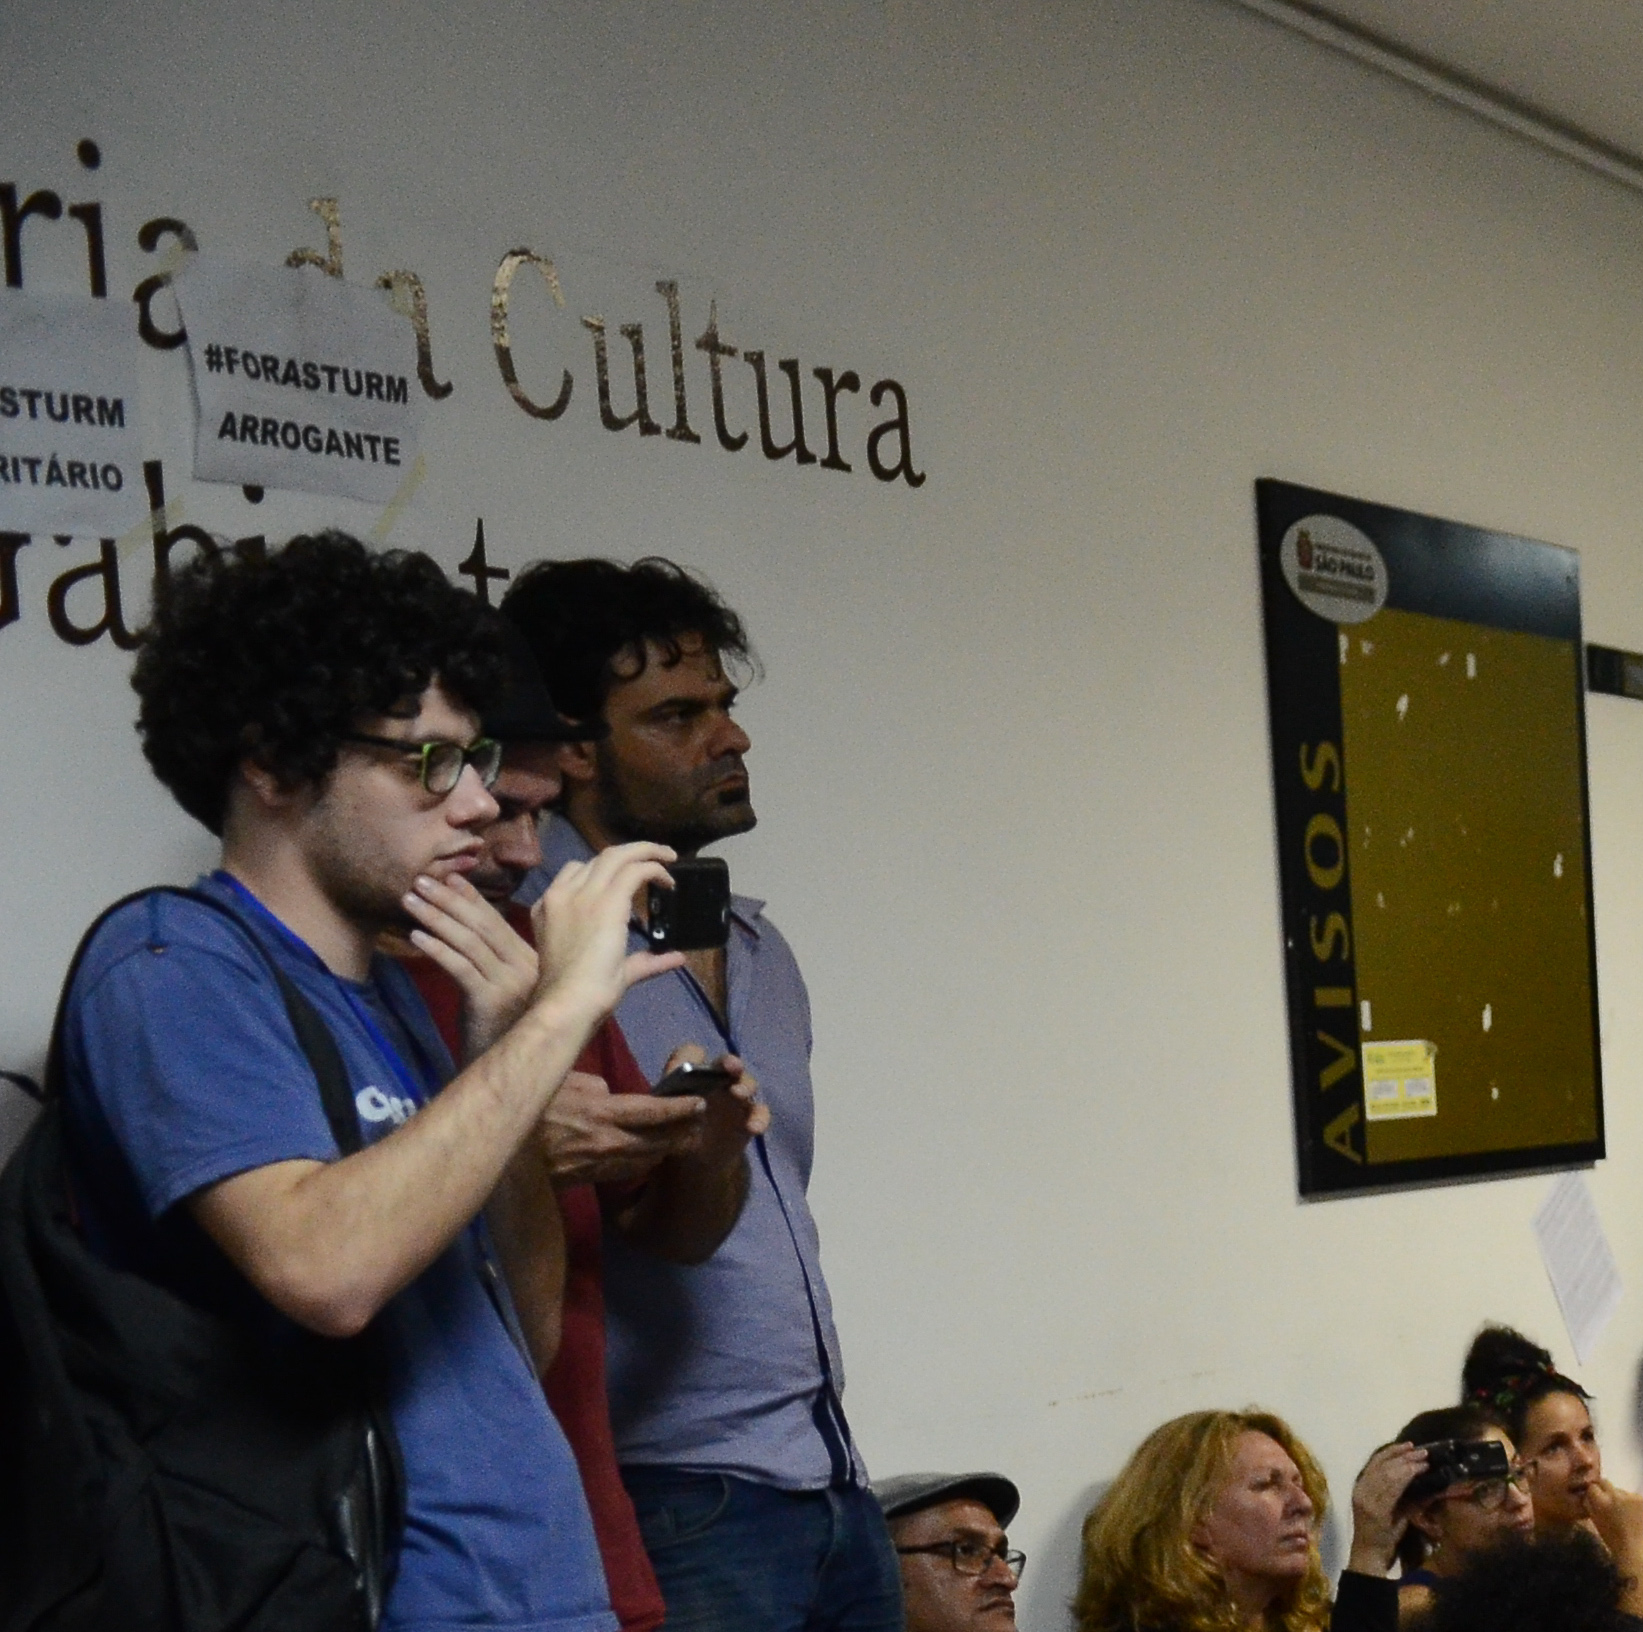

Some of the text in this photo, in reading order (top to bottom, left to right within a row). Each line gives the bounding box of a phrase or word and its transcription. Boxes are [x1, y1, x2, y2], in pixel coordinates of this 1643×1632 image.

[204, 342, 409, 405] #FORASTURM
[217, 411, 402, 466] ARROGANTE
[490, 247, 926, 488] Cultura
[1300, 740, 1363, 1164] AVISOS
